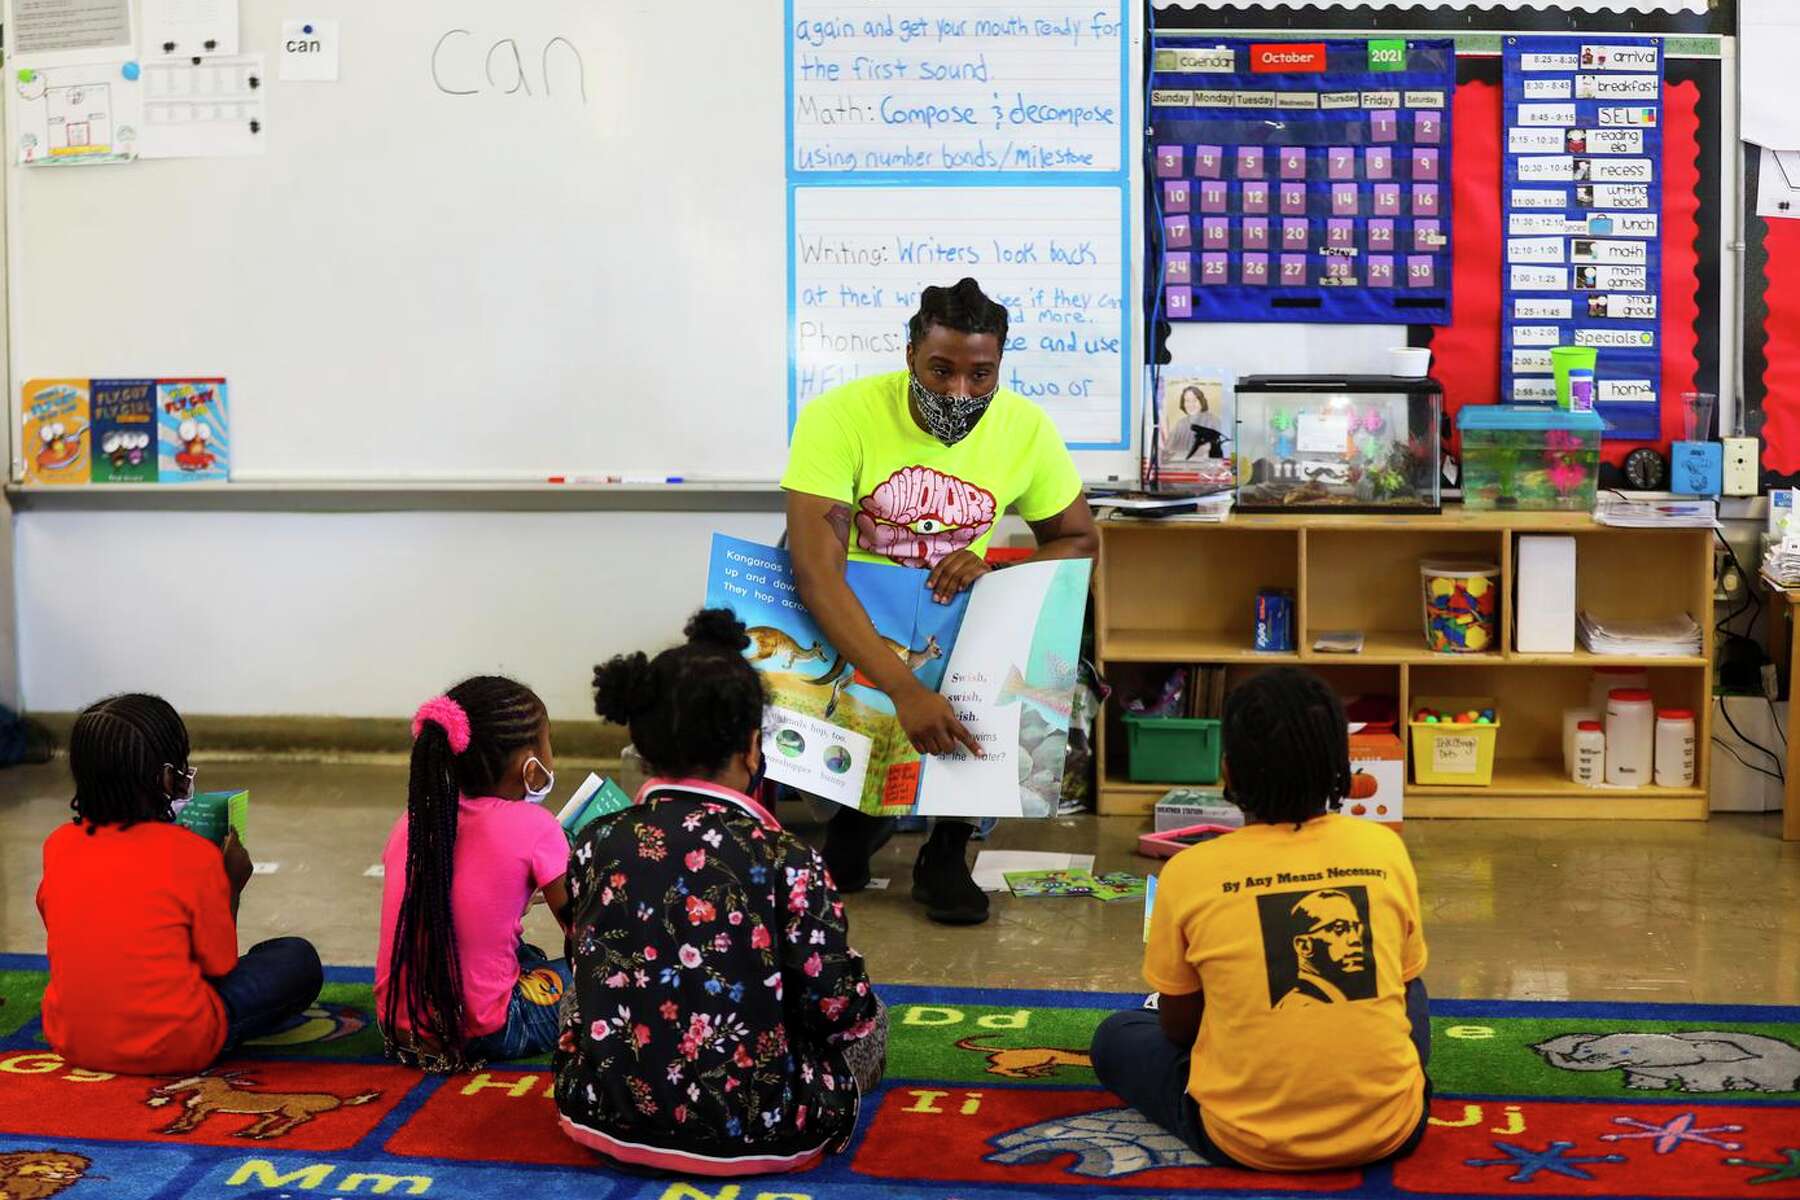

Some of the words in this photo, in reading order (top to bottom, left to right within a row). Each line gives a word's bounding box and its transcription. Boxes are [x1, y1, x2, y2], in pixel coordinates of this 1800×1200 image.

[796, 16, 854, 46] again
[864, 15, 893, 37] and
[900, 19, 928, 42] get
[938, 19, 966, 42] your
[976, 18, 1028, 36] mouth
[1035, 18, 1081, 46] ready
[1091, 12, 1122, 39] for
[286, 38, 321, 53] can
[1262, 52, 1314, 63] October
[1372, 50, 1402, 62] 2021
[1613, 51, 1655, 63] arrival
[800, 54, 840, 81] the
[853, 56, 908, 80] first
[1598, 81, 1658, 92] breakfast
[1153, 92, 1190, 105] Sunday
[1196, 92, 1233, 105] Monday
[1237, 95, 1273, 106] Tuesday
[1323, 94, 1358, 104] Thursday
[1364, 95, 1393, 106] Friday
[1407, 96, 1437, 105] Saturday
[797, 95, 875, 122] Math:
[1010, 92, 1114, 127] decompose
[1601, 108, 1639, 124] SEL
[1422, 120, 1432, 132] 2
[1594, 131, 1639, 143] reading
[799, 144, 857, 171] using
[865, 146, 931, 168] number
[1165, 155, 1174, 167] 3
[1203, 155, 1213, 167] 4
[1246, 156, 1255, 168] 5
[1288, 157, 1297, 168] 6
[1337, 156, 1346, 168] 7
[1375, 156, 1384, 168] 8
[1421, 157, 1430, 169] 9
[1600, 165, 1645, 176] recess
[1170, 191, 1185, 202] 10
[1208, 191, 1219, 202] 11
[1248, 192, 1263, 203] 12
[1286, 192, 1300, 204] 13
[1337, 193, 1352, 205] 14
[1380, 193, 1394, 205] 15
[1418, 193, 1432, 205] 16
[1622, 219, 1655, 231] lunch
[1171, 226, 1185, 238] 17
[1209, 228, 1223, 239] 18
[1249, 228, 1263, 240] 19
[1286, 228, 1304, 240] 20
[1332, 228, 1347, 240] 21
[1372, 228, 1390, 240] 22
[799, 234, 888, 265] Writing:
[896, 237, 980, 265] Writers
[993, 240, 1038, 264] look
[1050, 240, 1097, 265] back
[1609, 247, 1643, 257] math
[1168, 261, 1186, 273] 24
[1206, 262, 1223, 274] 25
[1246, 262, 1264, 275] 26
[1284, 263, 1301, 275] 27
[1330, 264, 1348, 276] 28
[1372, 264, 1390, 276] 29
[1411, 265, 1429, 277] 30
[1608, 278, 1644, 289] games
[803, 284, 825, 305] at
[840, 286, 882, 306] their
[1029, 287, 1045, 308] if
[1054, 288, 1092, 309] they
[1171, 295, 1186, 307] 31
[1623, 306, 1655, 318] group
[799, 321, 901, 352] Phonics:
[1040, 331, 1077, 352] and
[1085, 338, 1119, 354] use
[1576, 331, 1637, 345] Specials
[1010, 366, 1060, 396] two
[1068, 379, 1093, 397] or
[726, 550, 783, 572] Kangaroos
[725, 568, 738, 577] up
[746, 573, 766, 584] and
[723, 582, 748, 597] They
[755, 590, 774, 603] hop
[1222, 881, 1240, 893] By
[1245, 875, 1273, 888] Any
[1277, 871, 1324, 884] Means
